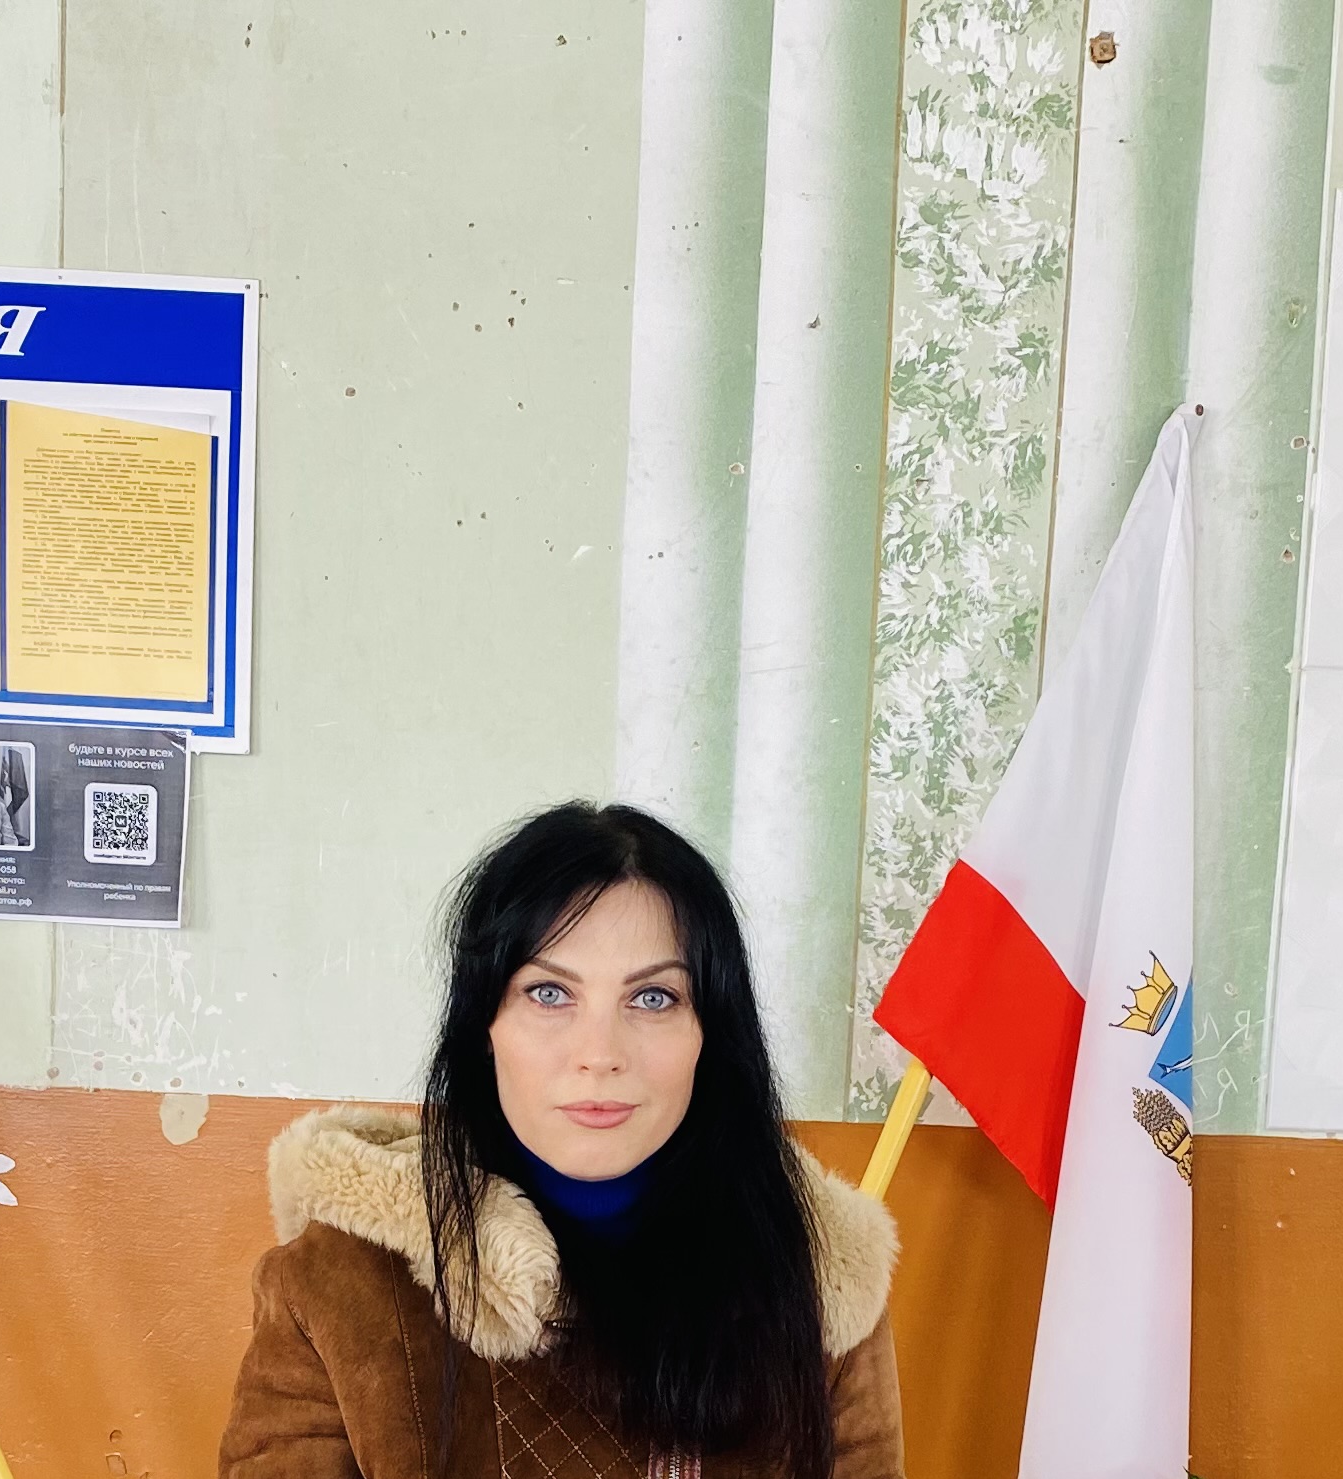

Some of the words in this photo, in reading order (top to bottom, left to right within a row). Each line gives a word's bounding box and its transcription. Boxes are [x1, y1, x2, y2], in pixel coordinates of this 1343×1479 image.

[68, 743, 105, 756] будьте
[107, 746, 114, 755] в
[115, 746, 147, 759] курсе
[149, 748, 174, 758] всех
[78, 757, 113, 768] наших
[113, 759, 165, 771] новостей
[133, 883, 144, 892] по
